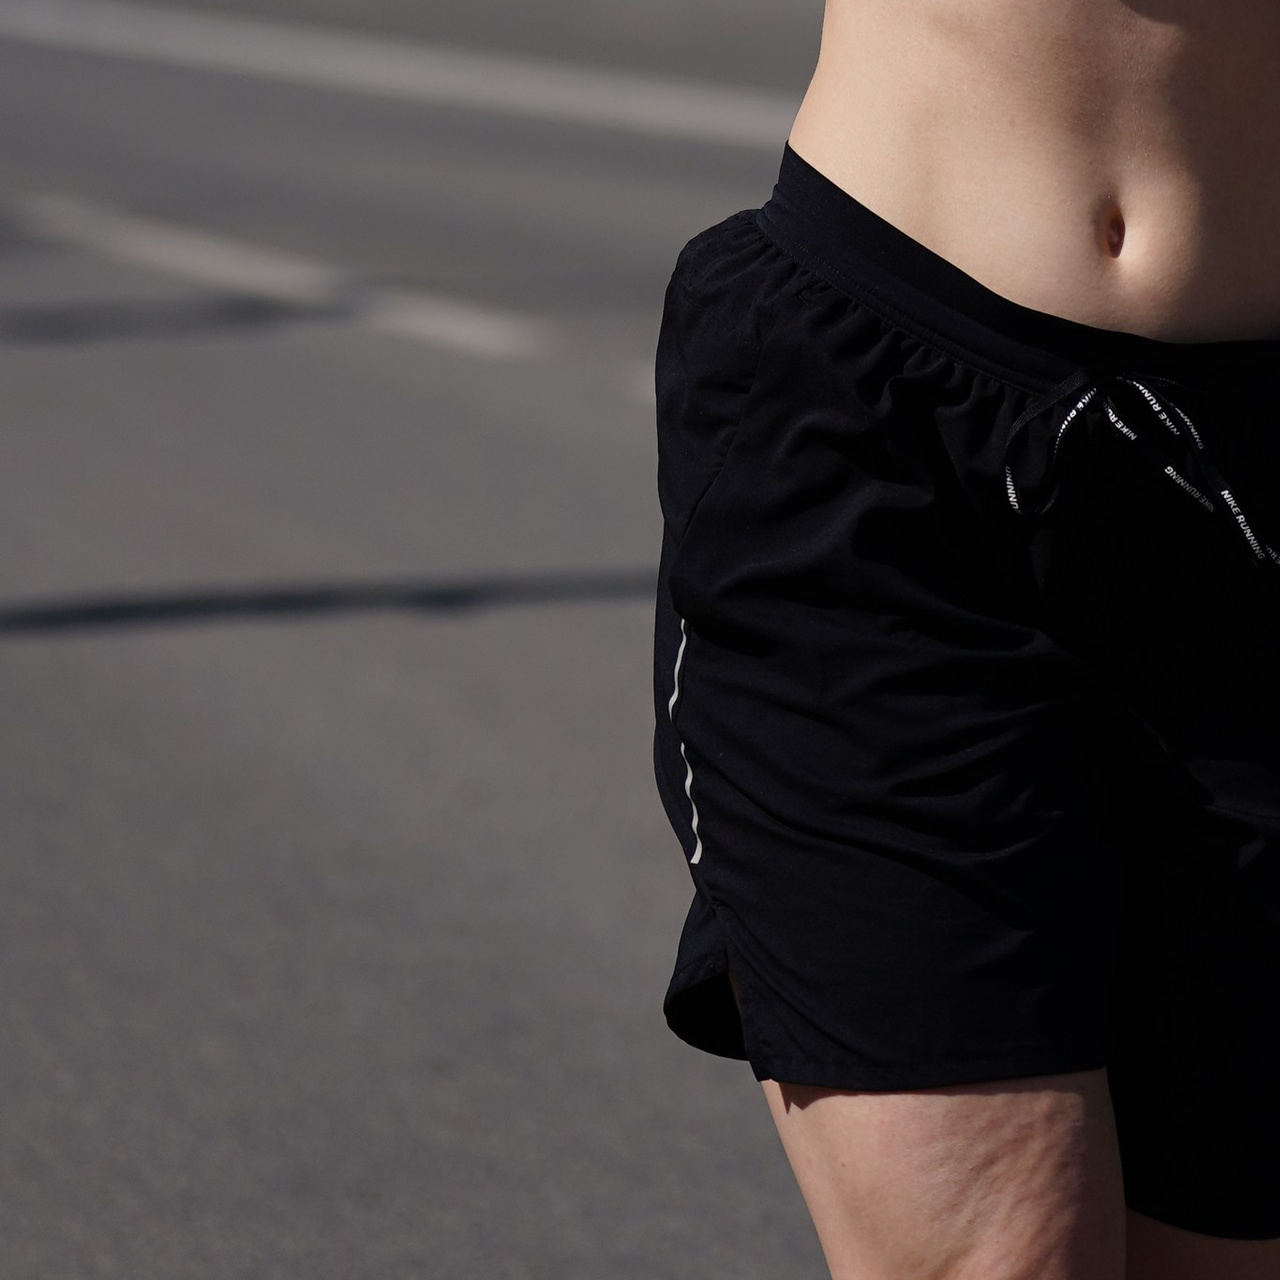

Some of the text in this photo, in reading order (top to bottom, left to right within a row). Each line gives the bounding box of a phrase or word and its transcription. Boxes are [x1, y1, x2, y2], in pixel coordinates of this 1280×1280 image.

[1114, 419, 1138, 441] NIKE
[1158, 411, 1181, 436] NIKE
[1164, 465, 1216, 513] NIKE RUNNING
[1220, 489, 1266, 560] NIKE RUNNING
